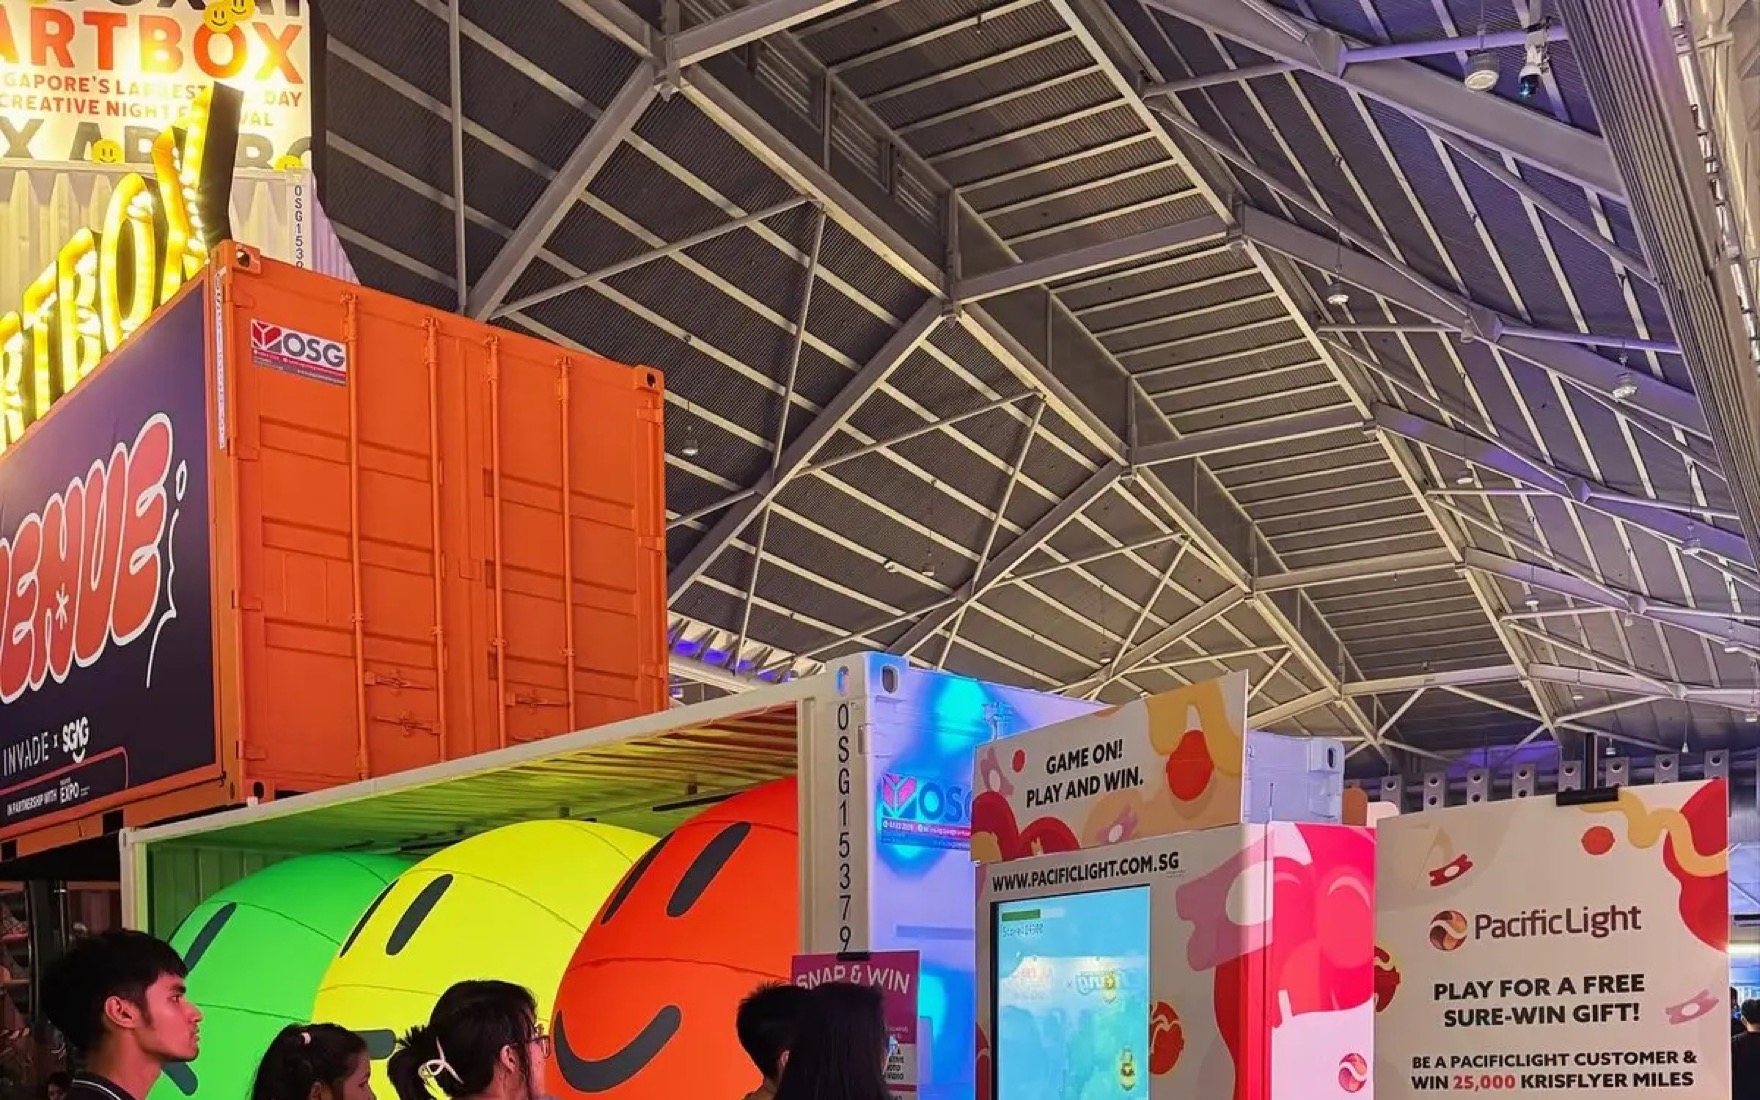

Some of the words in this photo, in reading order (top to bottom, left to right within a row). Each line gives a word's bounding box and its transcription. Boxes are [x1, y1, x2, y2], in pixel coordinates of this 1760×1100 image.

[282, 332, 346, 368] OSG
[0, 412, 172, 704] ENUE
[3, 731, 49, 777] INVADE
[1046, 747, 1089, 774] GAME
[1092, 739, 1123, 763] ON!
[919, 782, 973, 822] OS
[1026, 785, 1063, 808] PLAY
[1065, 775, 1100, 800] AND
[1103, 766, 1144, 791] WIN.
[992, 851, 1180, 892] WWW.PACIFICLIGHT.COM.SG
[1475, 905, 1642, 940] PacificLight
[796, 965, 846, 991] SNAP
[867, 964, 910, 994] WIN
[1434, 979, 1494, 1001] PLAY
[1500, 978, 1551, 999] FOR
[1557, 976, 1577, 996] A
[1583, 974, 1645, 995] FREE
[1444, 1006, 1566, 1028] SURE-WIN
[1573, 1003, 1641, 1024] GIFT!
[1412, 1056, 1432, 1070] BE
[1434, 1055, 1447, 1069] A
[1451, 1053, 1569, 1069] PACIFICLIGHT
[1574, 1051, 1680, 1066] CUSTOMER
[1683, 1050, 1698, 1064] &
[1411, 1076, 1449, 1091] WIN
[1453, 1075, 1516, 1093] 25,000
[1521, 1073, 1629, 1090] KRISFLYER
[1633, 1072, 1695, 1088] MILES
